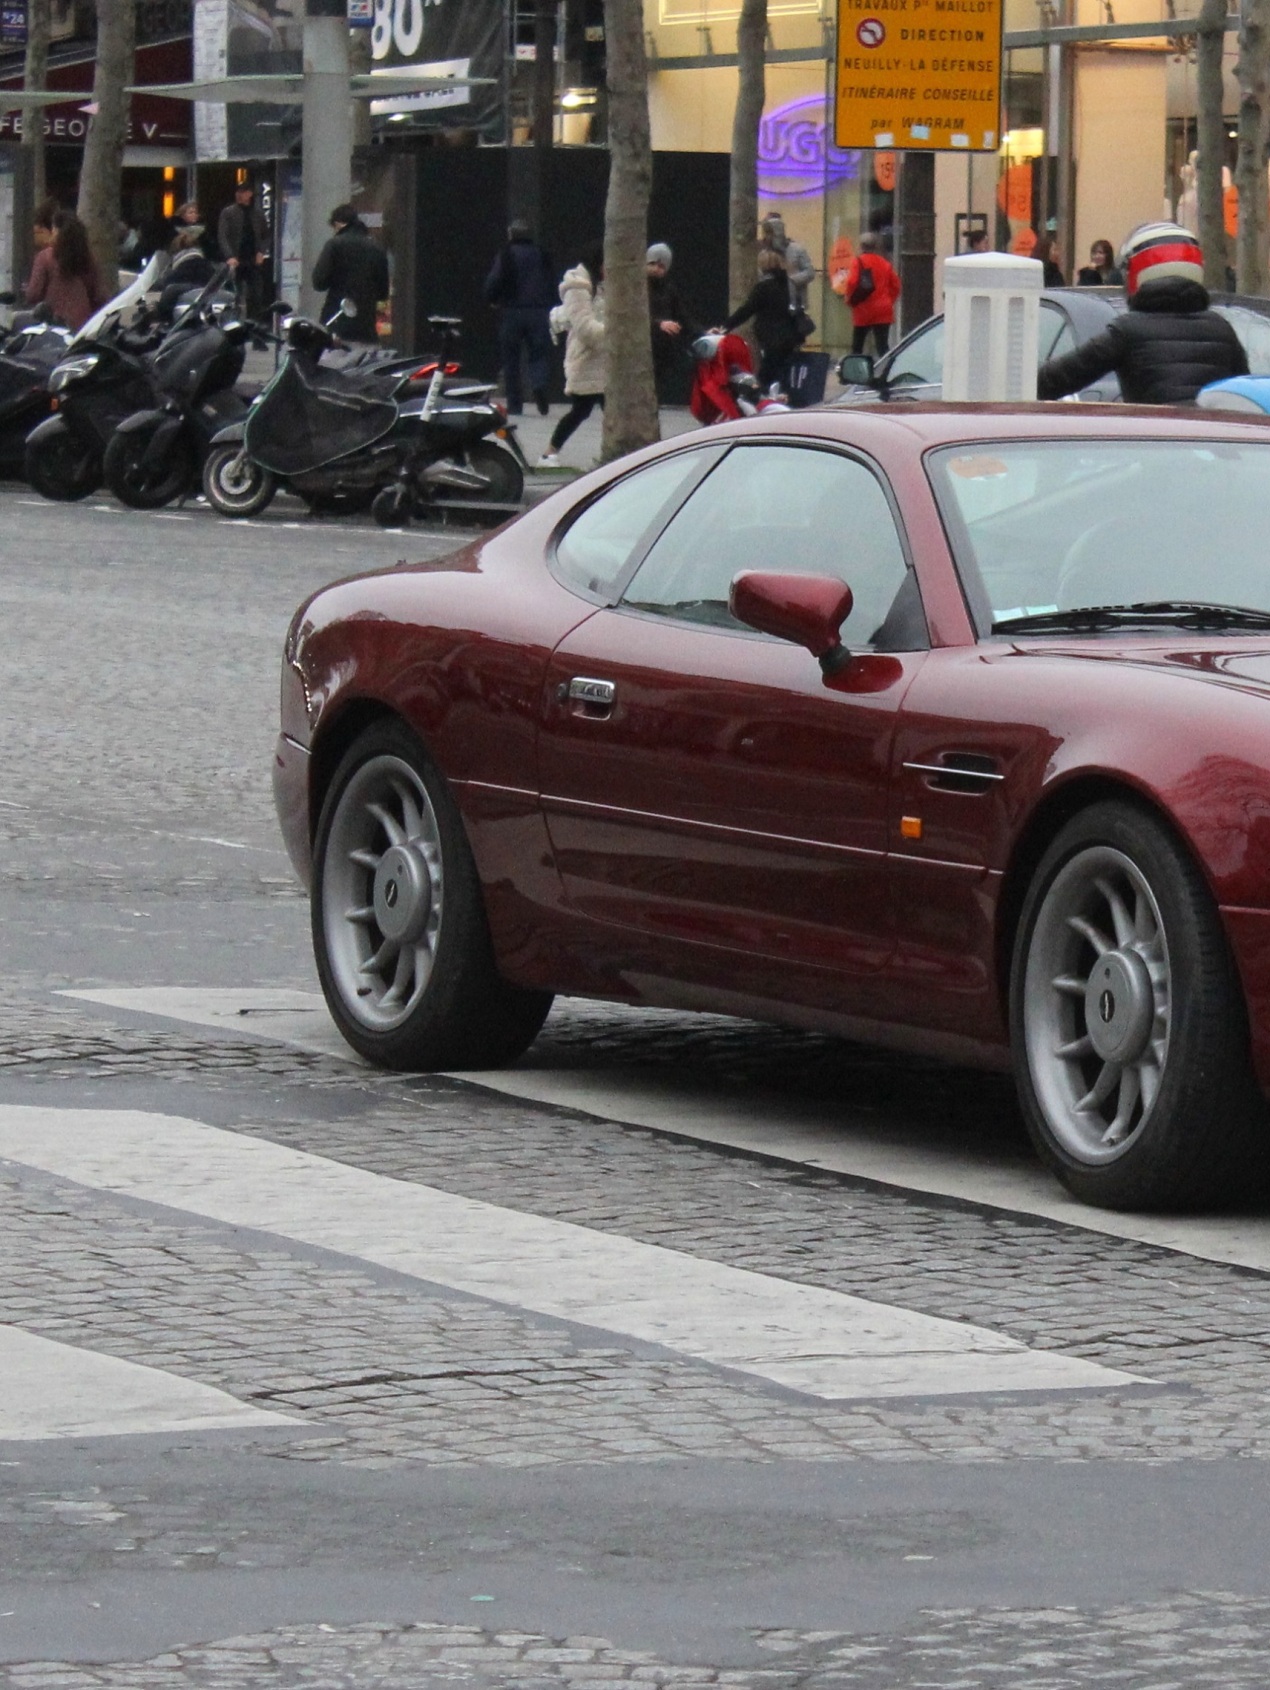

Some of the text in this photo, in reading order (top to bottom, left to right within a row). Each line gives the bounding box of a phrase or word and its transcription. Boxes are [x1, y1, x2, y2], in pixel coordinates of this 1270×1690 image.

[848, 0, 906, 12] TRAVAUX
[935, 0, 994, 13] MAILLOT
[901, 28, 985, 42] DIRECTION
[932, 58, 994, 72] DÉFENSE
[842, 84, 916, 101] ITINÉRAIRE
[871, 118, 892, 130] par
